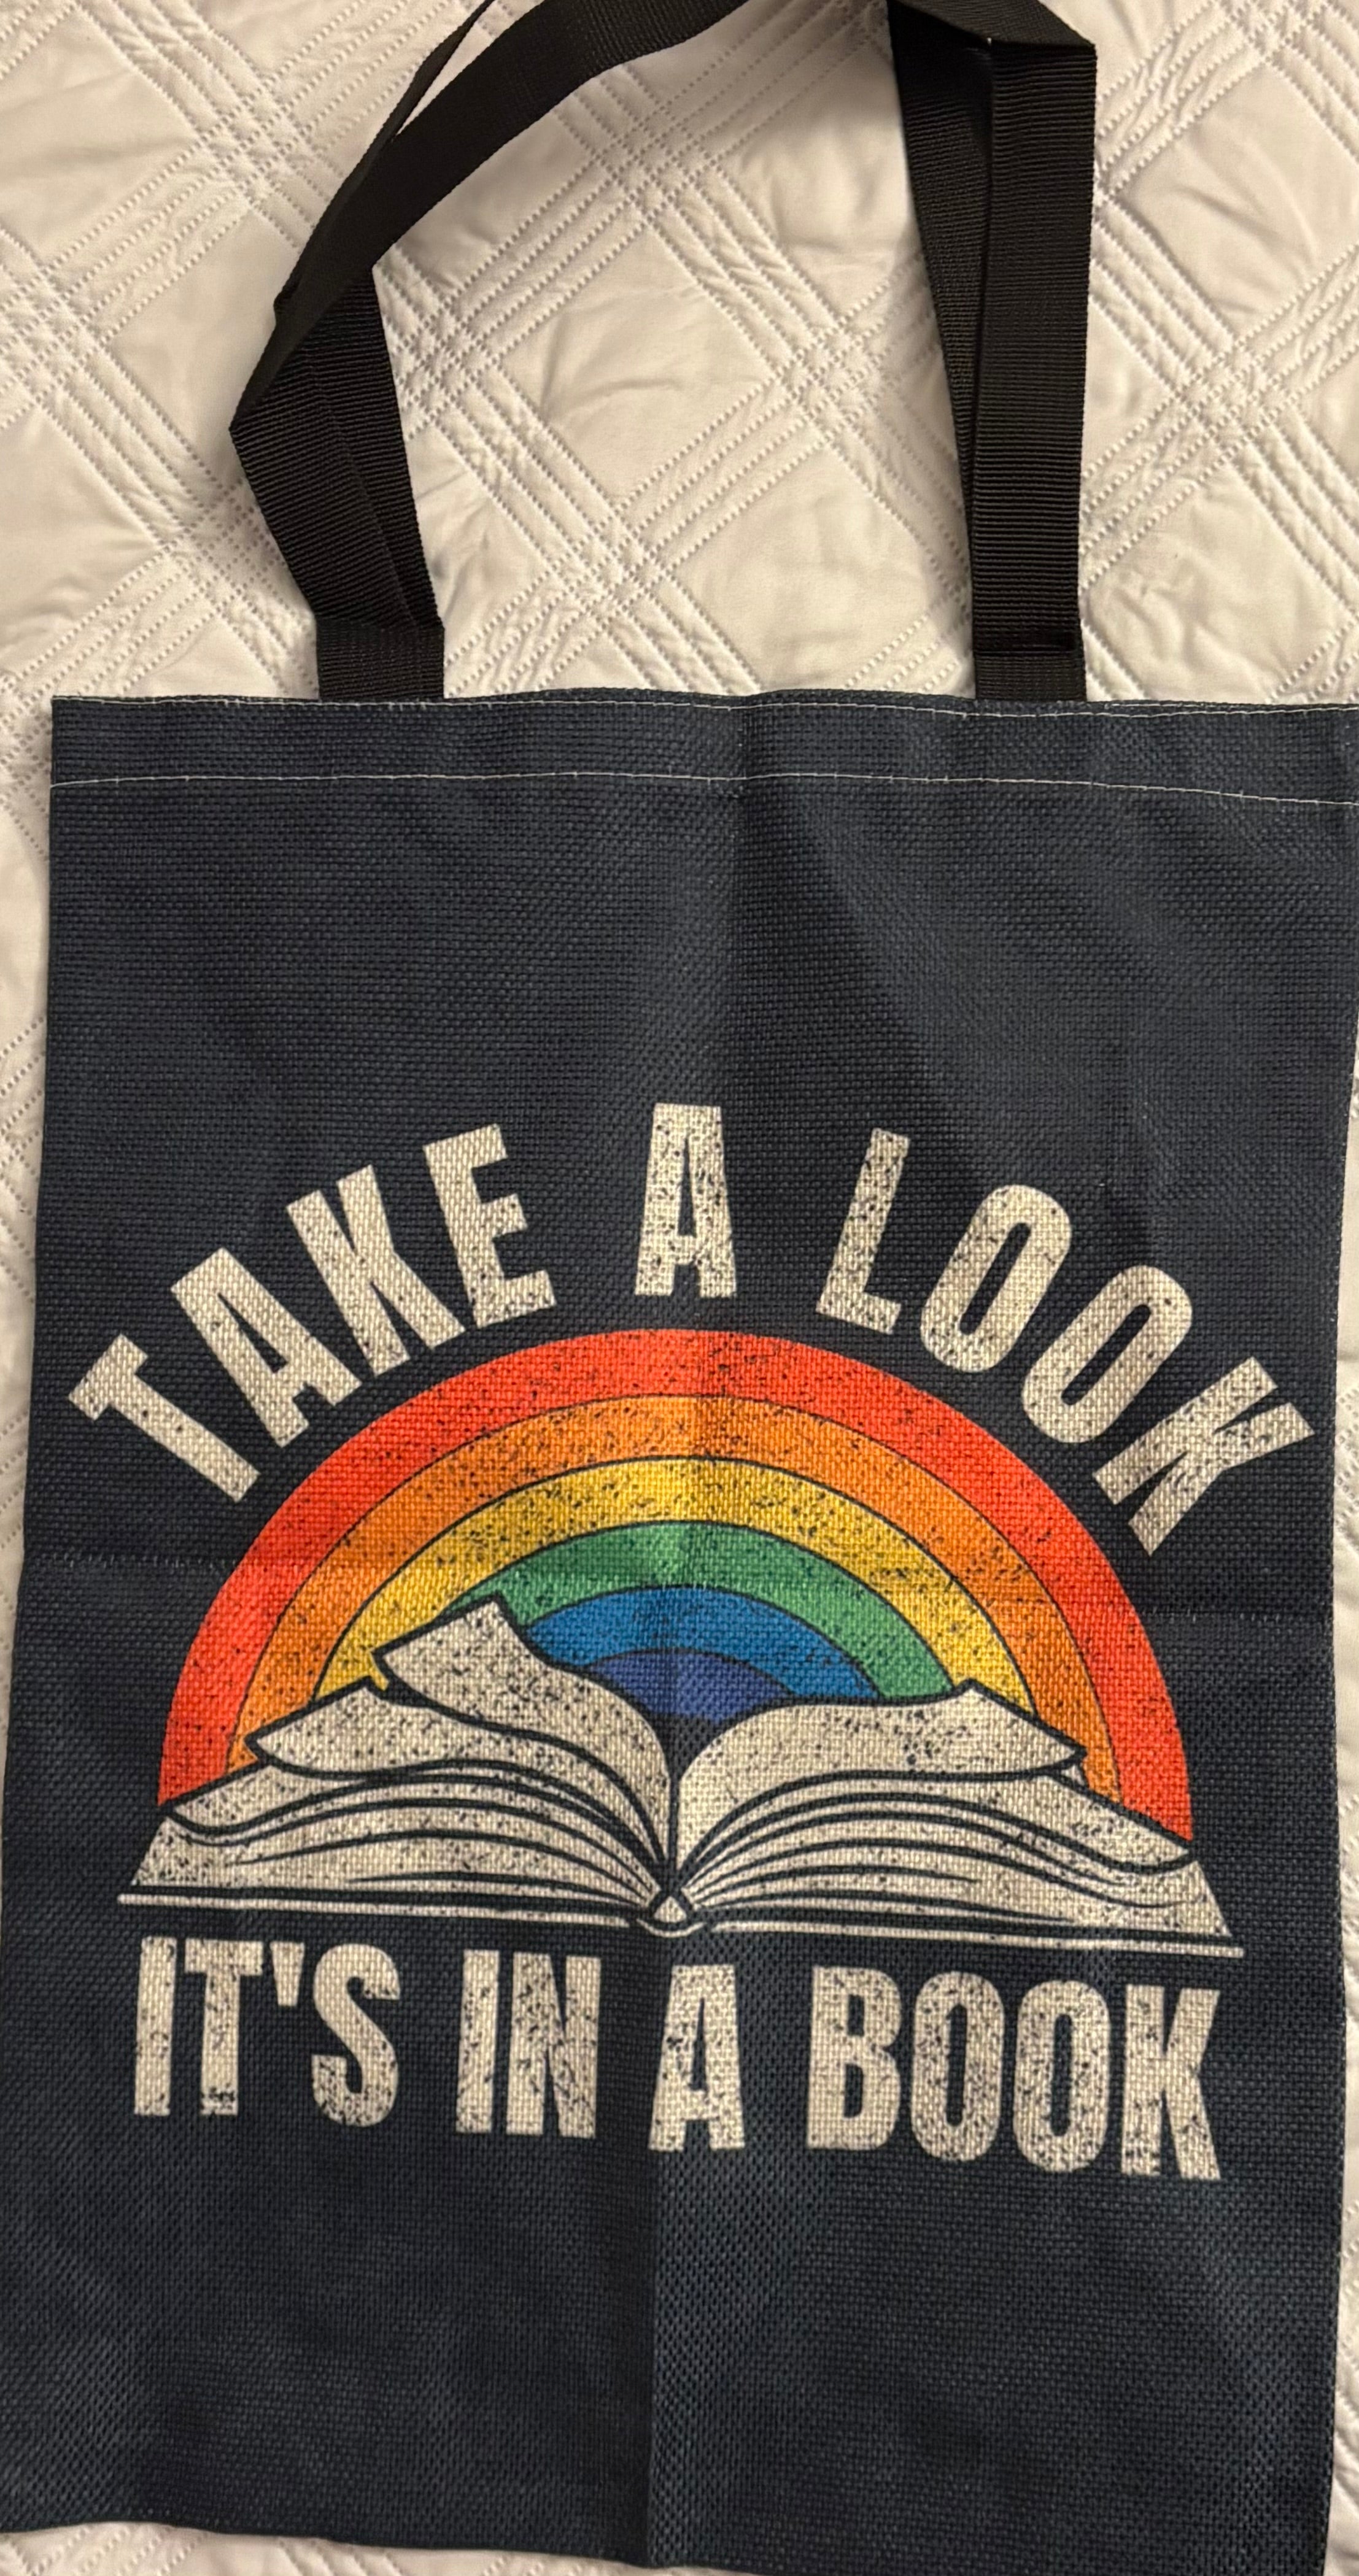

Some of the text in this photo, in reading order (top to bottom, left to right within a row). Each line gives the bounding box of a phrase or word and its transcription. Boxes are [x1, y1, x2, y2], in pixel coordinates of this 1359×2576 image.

[68, 1102, 1314, 1556] TAKE A LOOK
[133, 1936, 1222, 2181] IT'S IN A BOOK
